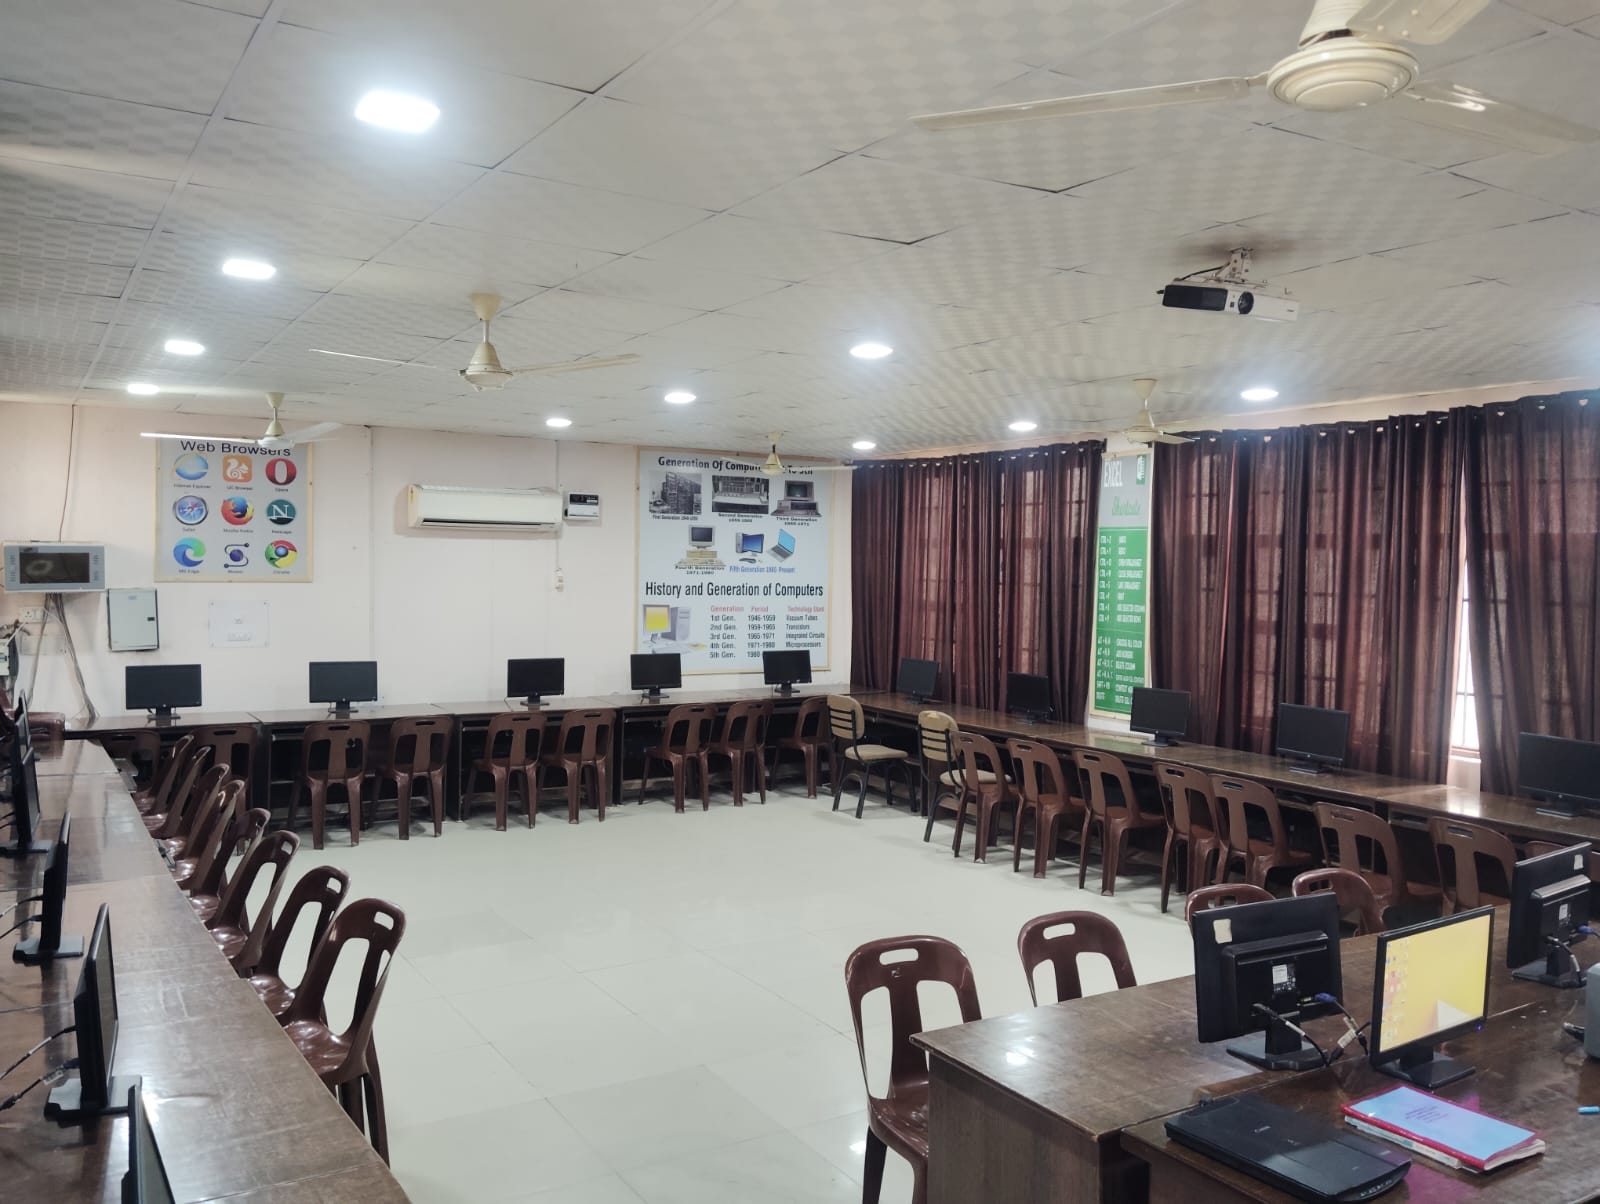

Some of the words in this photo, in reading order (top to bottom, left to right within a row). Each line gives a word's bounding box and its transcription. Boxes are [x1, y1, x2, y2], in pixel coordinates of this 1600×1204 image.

[181, 440, 215, 453] Web
[221, 443, 291, 457] Browsers
[658, 456, 709, 469] Generation
[712, 460, 723, 471] Of
[645, 582, 682, 599] History
[685, 582, 703, 596] and
[707, 582, 760, 597] Generation
[763, 583, 772, 596] of
[775, 583, 824, 599] Computers
